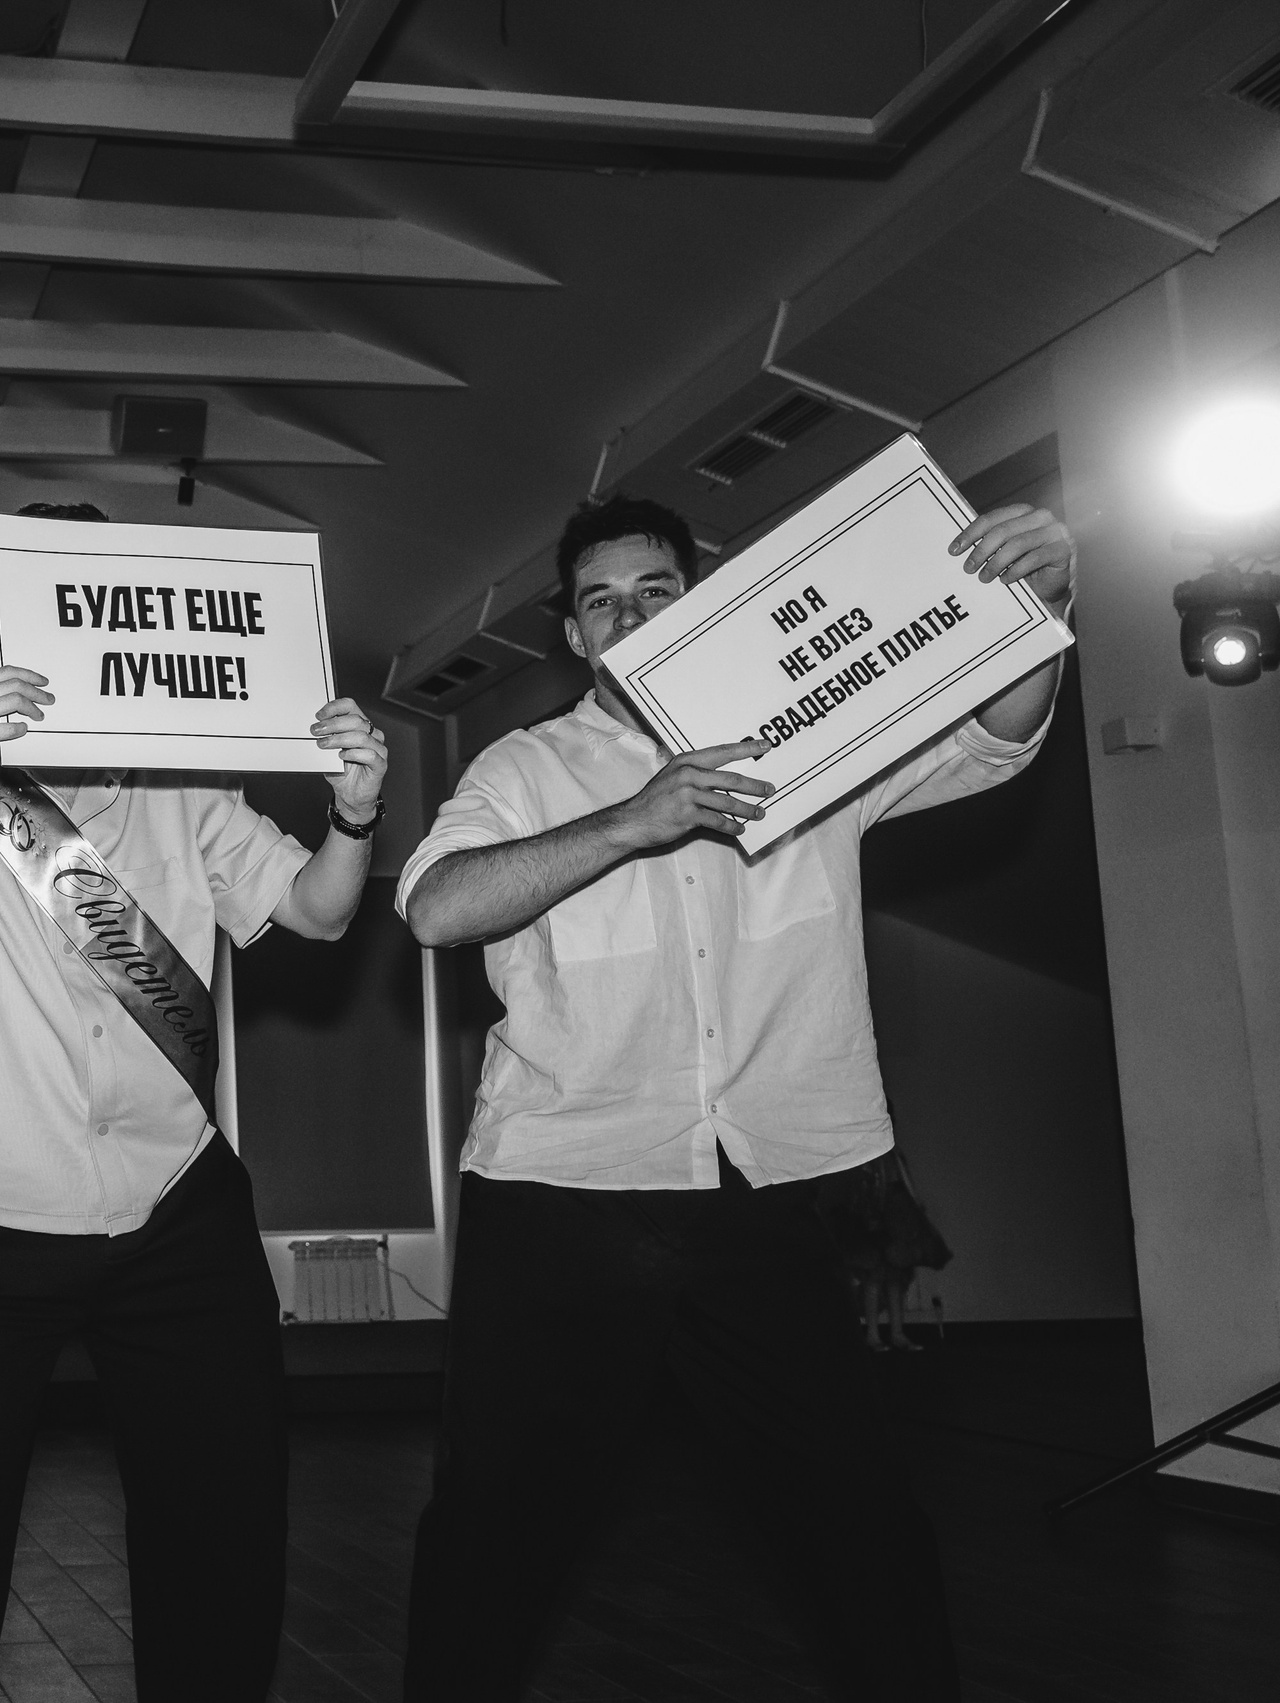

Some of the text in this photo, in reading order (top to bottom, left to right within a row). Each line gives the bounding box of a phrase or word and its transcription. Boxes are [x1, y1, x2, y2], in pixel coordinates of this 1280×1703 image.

[55, 583, 266, 638] БУДЕТ ЕЩЕ
[769, 585, 828, 635] НО Я
[99, 651, 249, 702] ЛУЧШЕ!
[758, 593, 970, 749] СВАДЕБНОЕ ПЛАТЬЕ
[777, 607, 874, 683] НЕ ВЛЕЗ
[53, 845, 211, 1057] Свидетель
